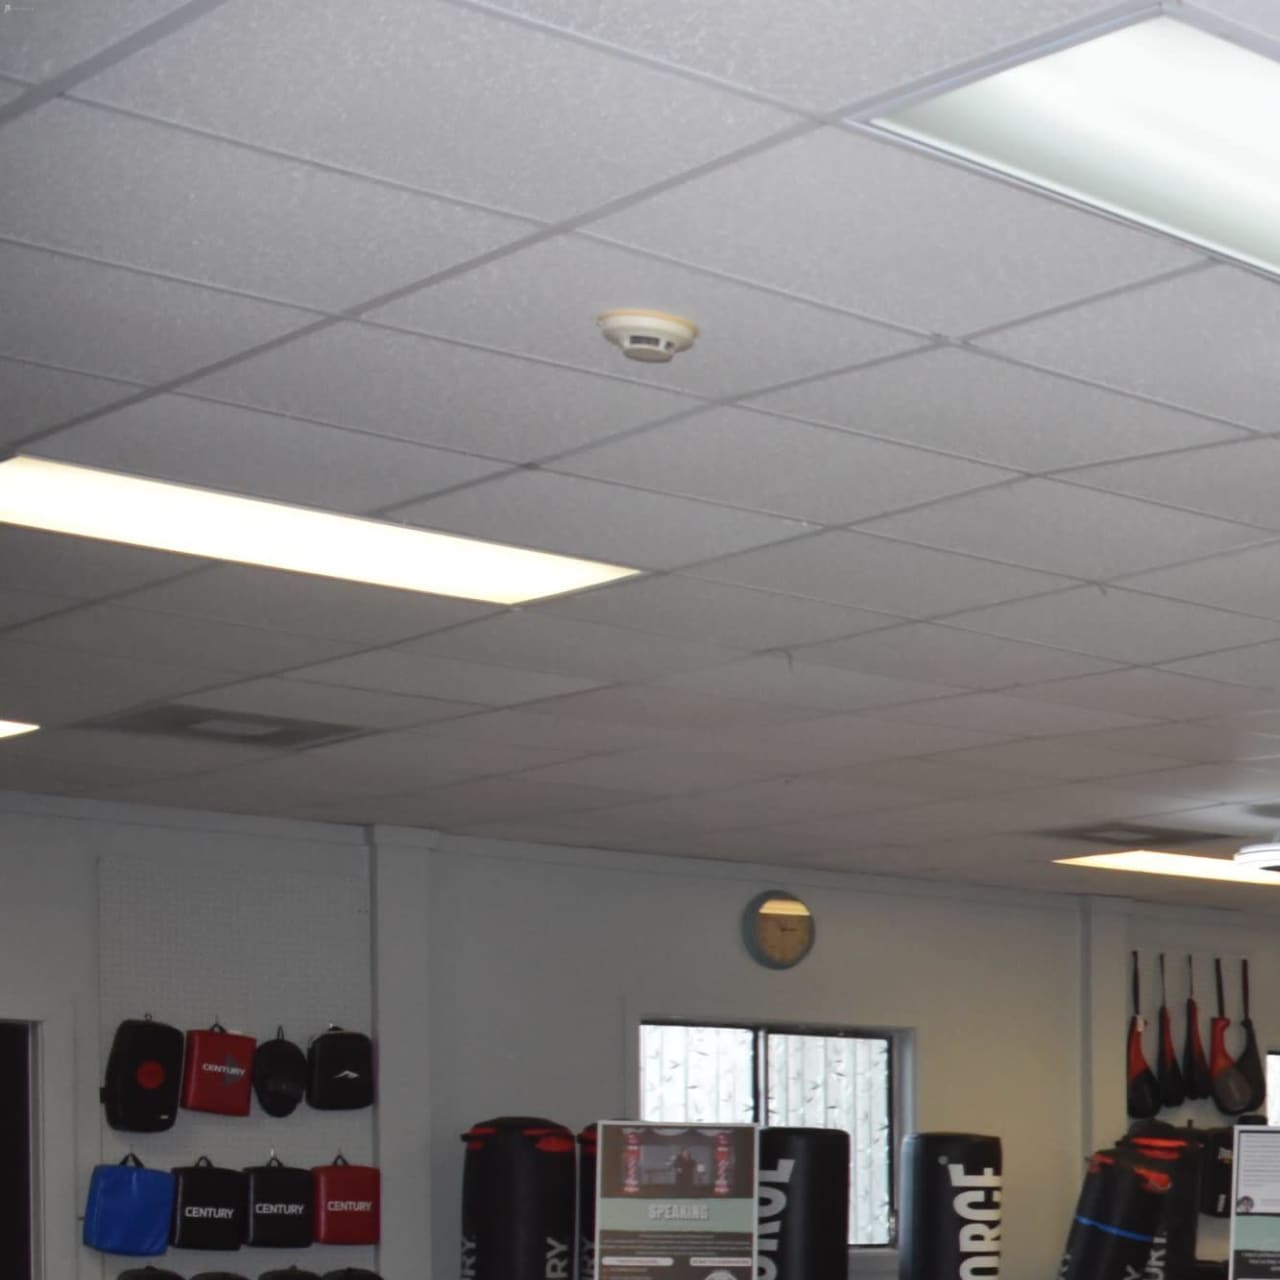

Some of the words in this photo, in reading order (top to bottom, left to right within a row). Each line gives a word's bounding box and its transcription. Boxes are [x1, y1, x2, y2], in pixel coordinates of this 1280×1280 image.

[202, 1063, 246, 1076] CENTURY
[184, 1205, 235, 1220] CENTURY
[255, 1202, 305, 1215] CENTURY
[327, 1200, 373, 1212] CENTURY
[647, 1203, 709, 1220] SPEAKING
